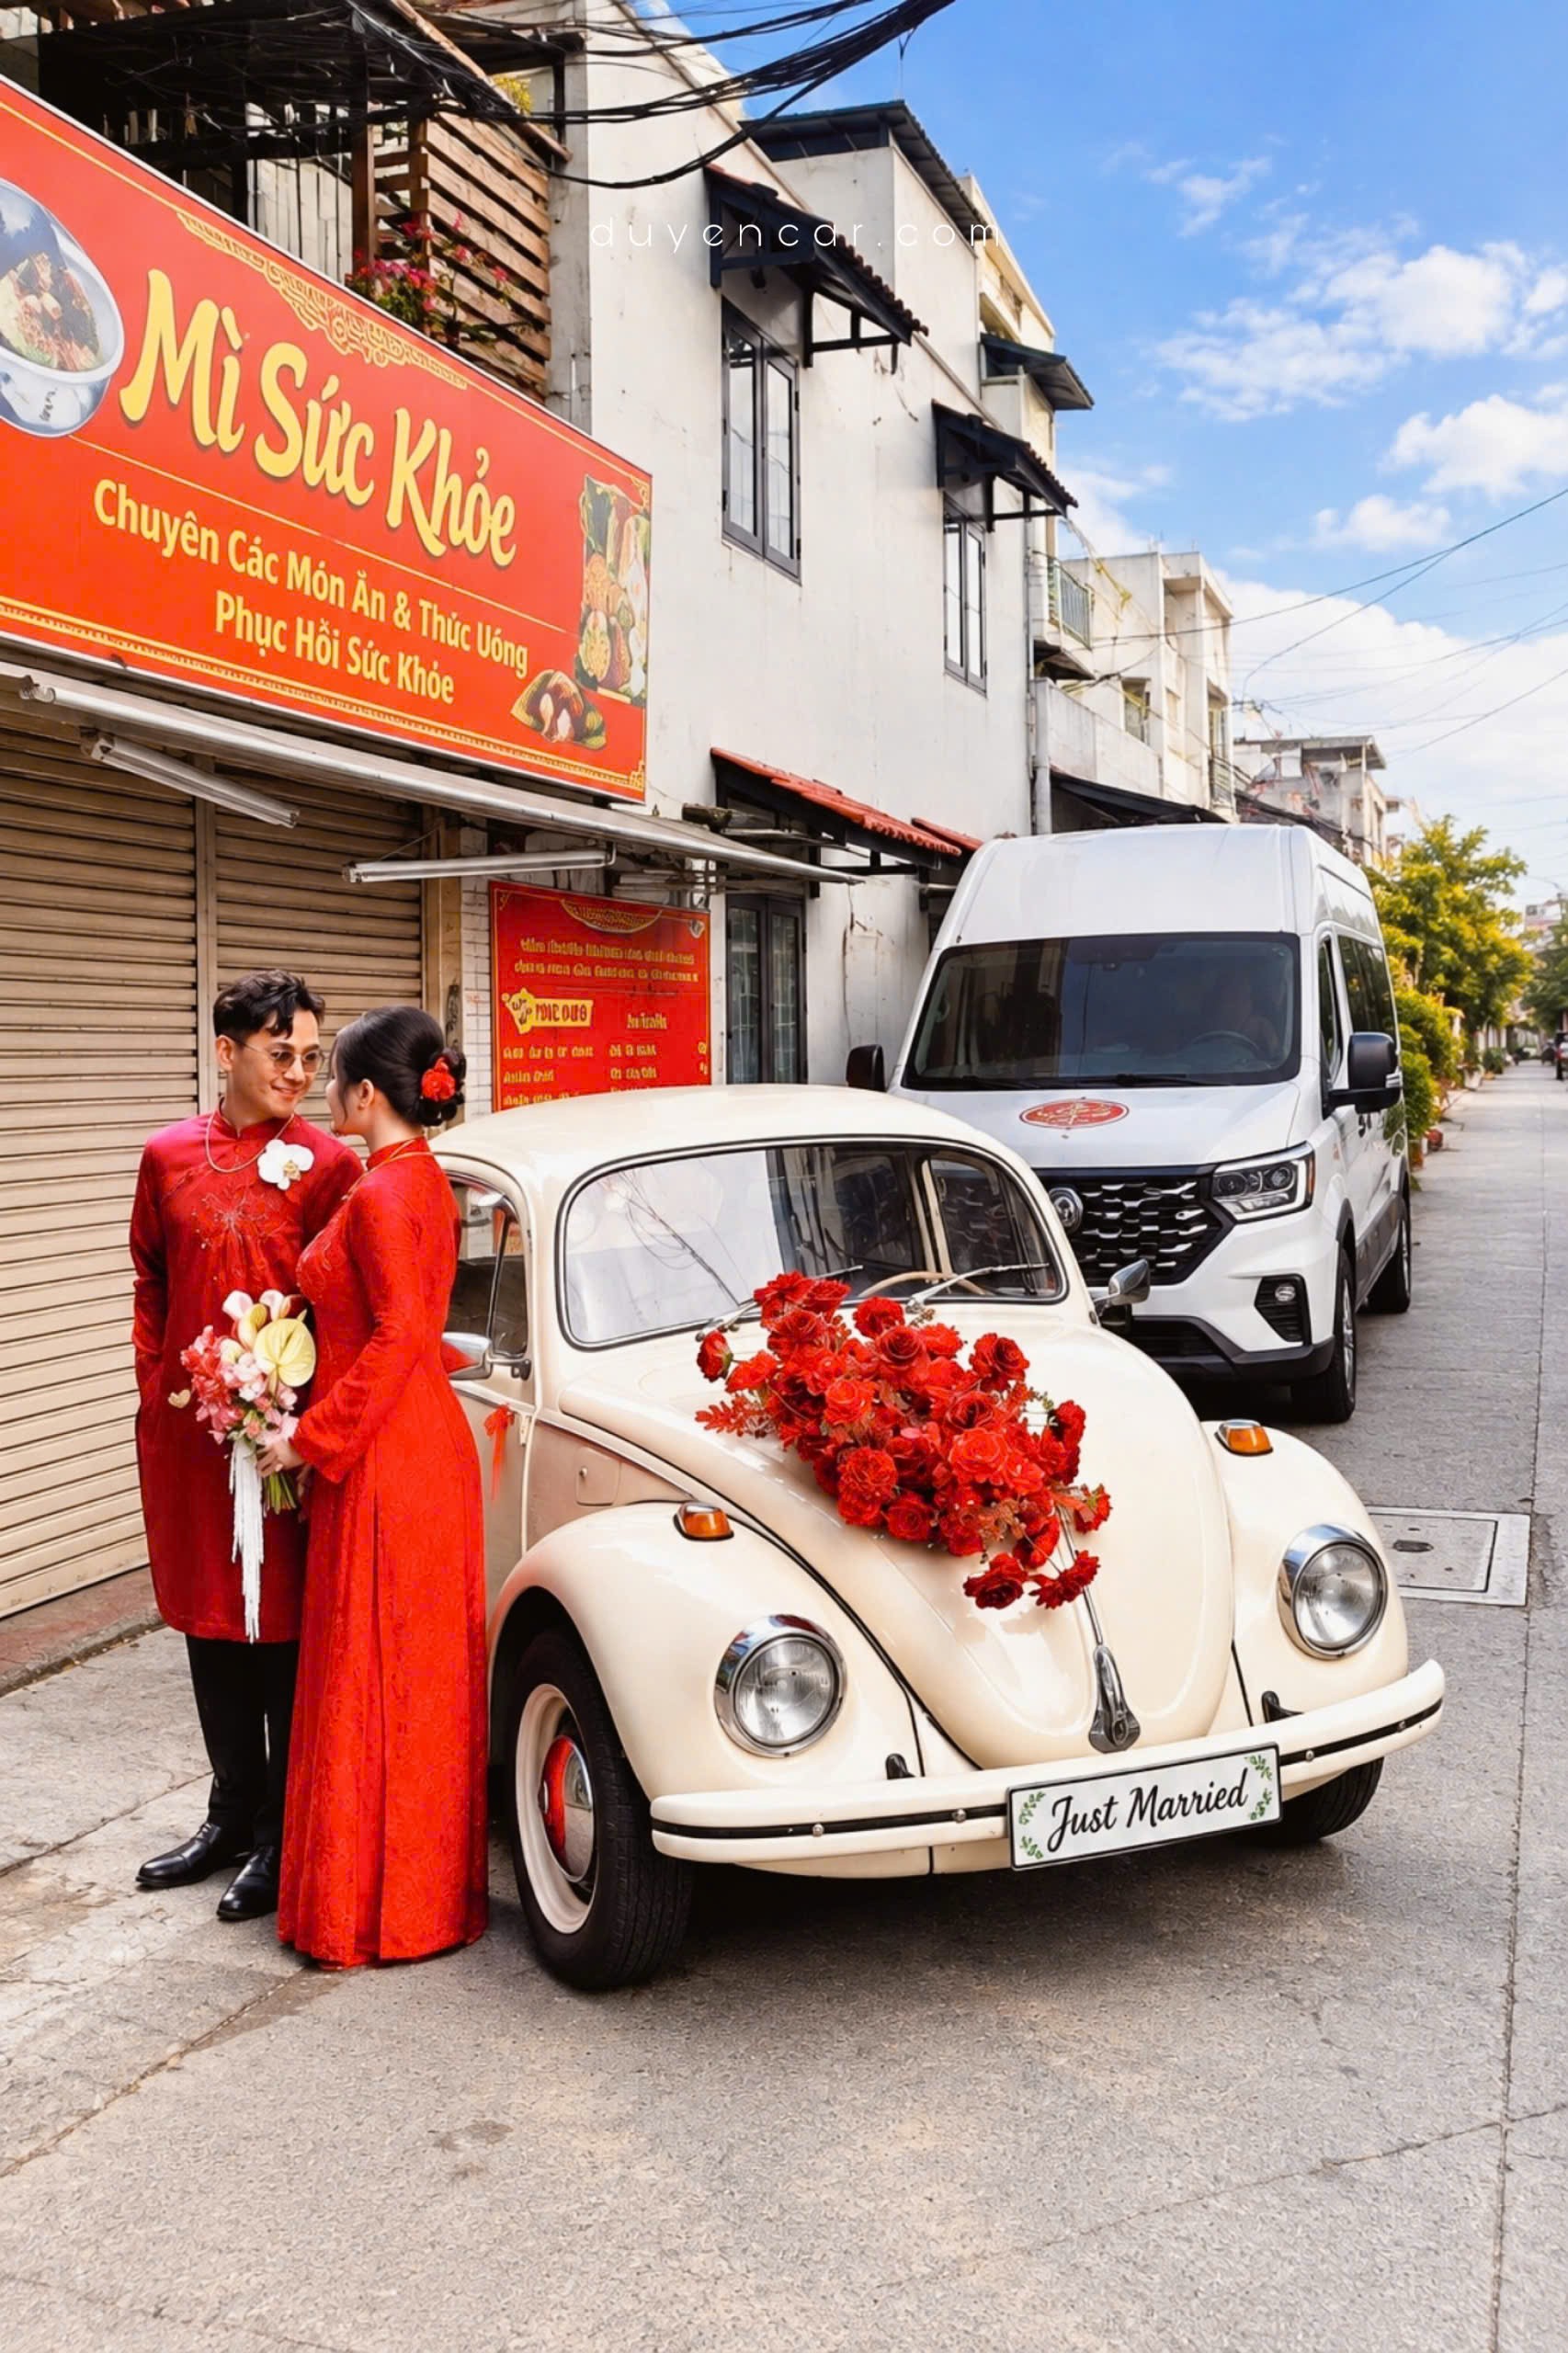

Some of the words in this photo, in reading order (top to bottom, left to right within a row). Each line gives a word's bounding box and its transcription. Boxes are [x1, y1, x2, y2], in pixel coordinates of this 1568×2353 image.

[119, 267, 245, 453] Mì
[254, 341, 376, 506] Sức
[386, 407, 517, 567] Khỏe
[94, 479, 220, 564] Chuyên
[287, 551, 345, 609] Món
[351, 570, 386, 623] Ăn
[393, 591, 412, 631] &
[419, 598, 472, 652] Thức
[215, 590, 288, 657] Phục
[347, 636, 391, 685] Sức
[1047, 1794, 1119, 1853] Just
[1126, 1768, 1249, 1827] Married
